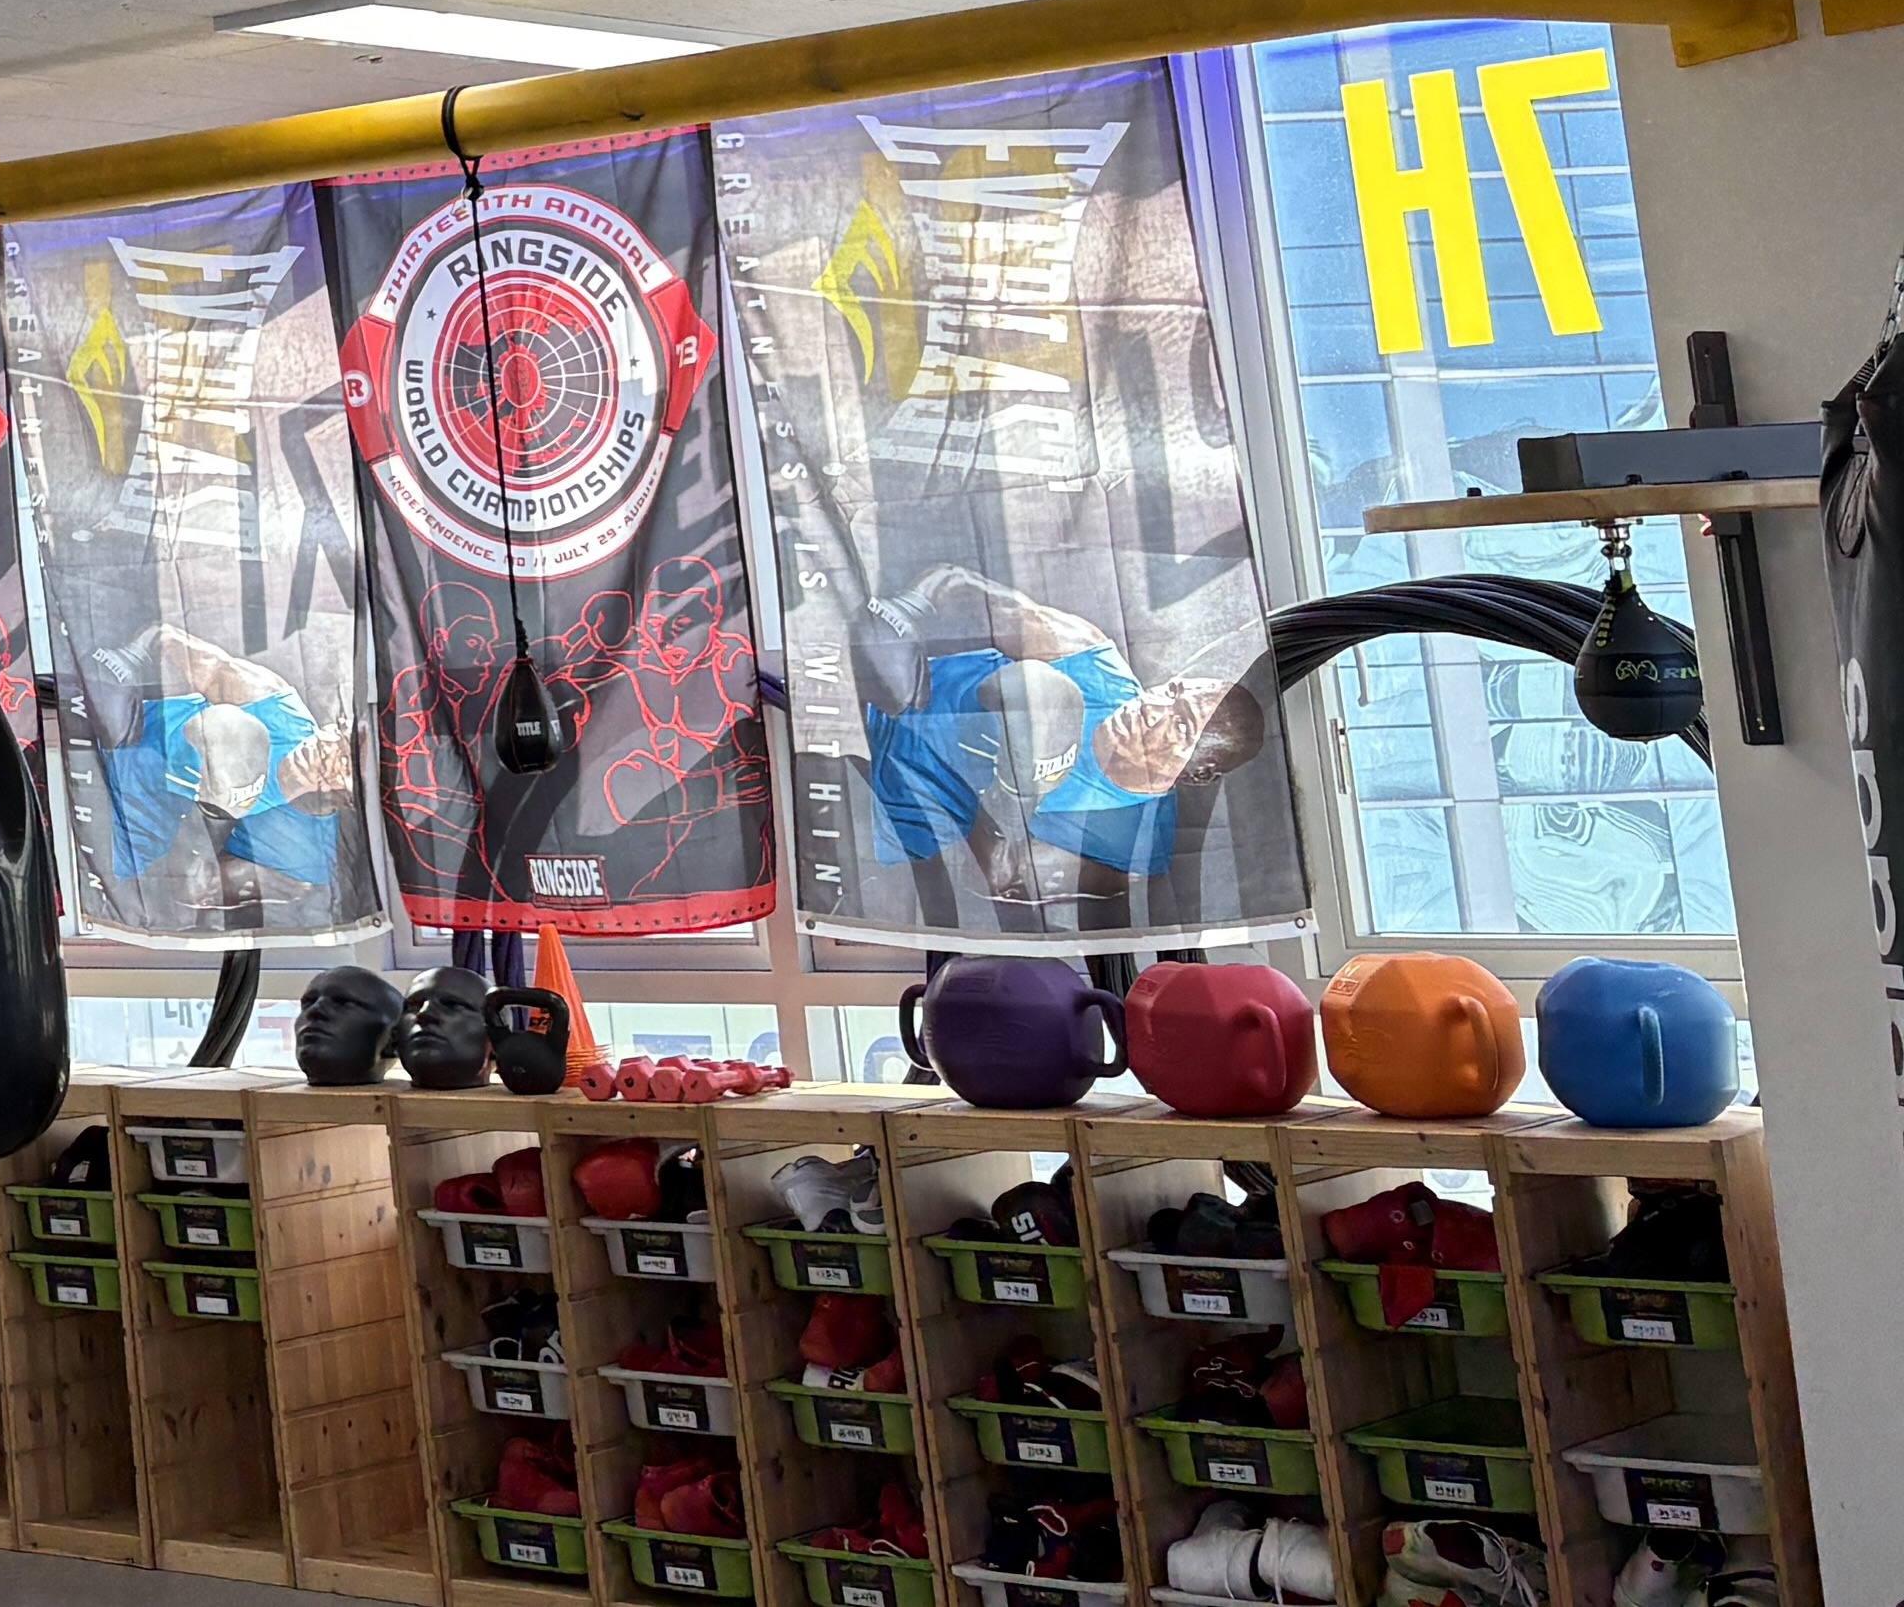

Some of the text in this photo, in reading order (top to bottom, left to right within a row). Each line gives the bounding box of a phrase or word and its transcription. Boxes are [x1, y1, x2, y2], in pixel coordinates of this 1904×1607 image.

[544, 197, 654, 284] ANNUAL
[857, 114, 1130, 492] EVERLAST
[107, 236, 305, 562] EVERLAST
[403, 359, 645, 523] WORLD CHAMPIONSHIPS
[716, 132, 809, 481] GREATNESS
[793, 543, 828, 590] IS
[515, 720, 542, 737] TITLE
[528, 857, 604, 898] RINGSIDE
